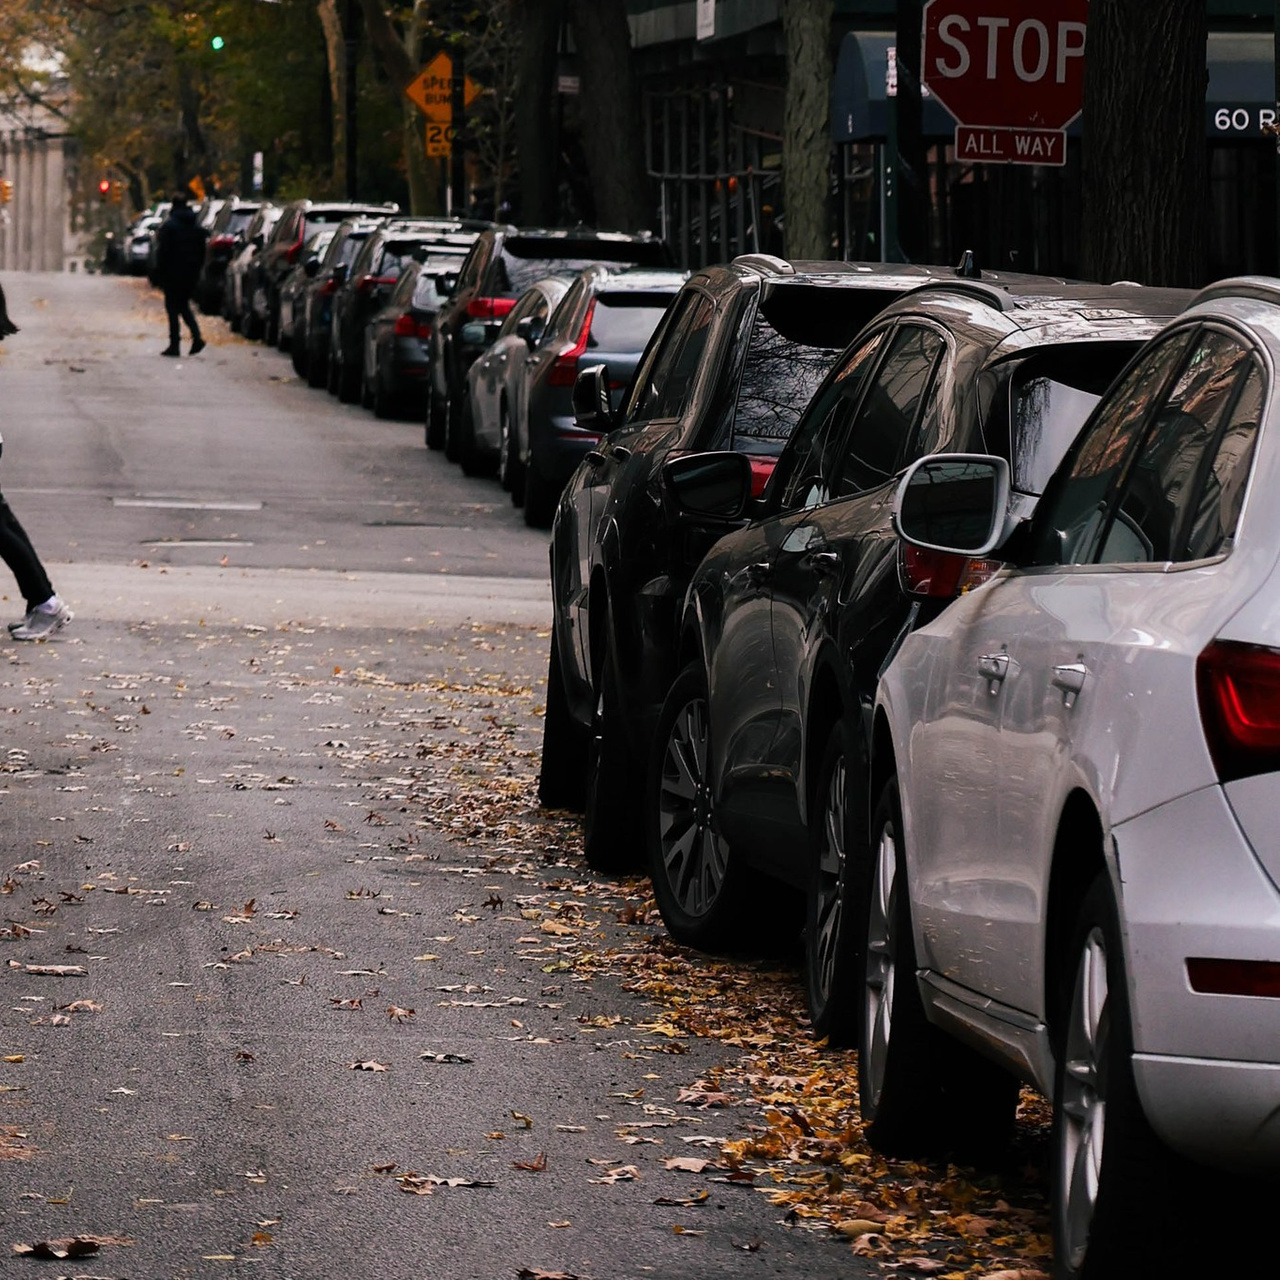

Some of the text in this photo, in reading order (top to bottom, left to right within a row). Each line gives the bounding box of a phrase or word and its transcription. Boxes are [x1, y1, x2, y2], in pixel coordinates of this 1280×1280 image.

[935, 14, 1087, 83] STOP
[1215, 108, 1249, 130] 60
[965, 133, 1056, 156] ALL WAY
